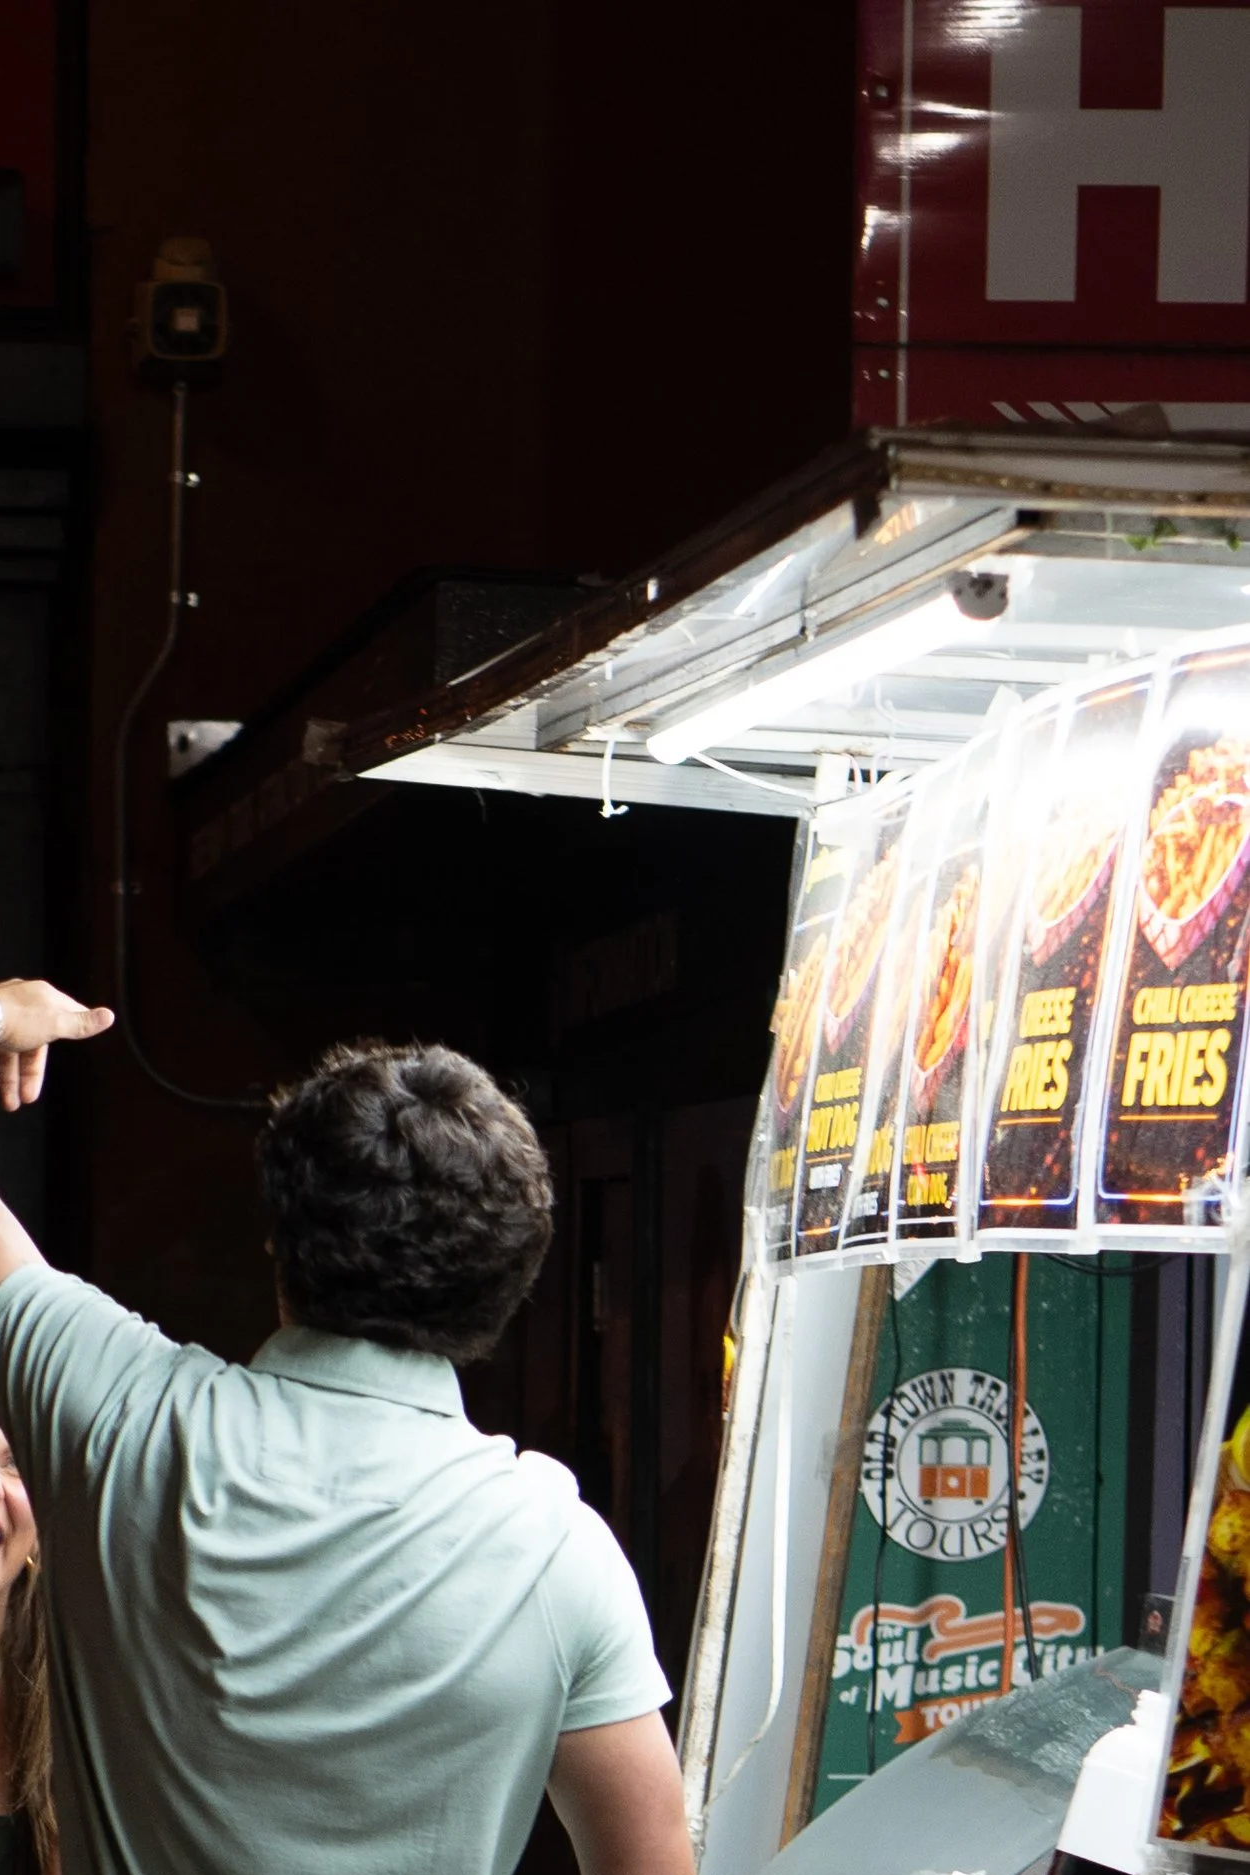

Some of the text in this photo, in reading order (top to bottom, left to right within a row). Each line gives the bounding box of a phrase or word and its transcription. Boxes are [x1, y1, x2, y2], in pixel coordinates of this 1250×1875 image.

[1019, 986, 1077, 1039] CHEESE
[1178, 983, 1239, 1024] CHEESE
[1000, 1039, 1073, 1113] FRIES
[1121, 1028, 1232, 1107] FRIES
[863, 1430, 897, 1481] OLD
[880, 1372, 955, 1429] TOWN
[887, 1498, 1012, 1559] TOURS
[866, 1654, 1000, 1713] Music
